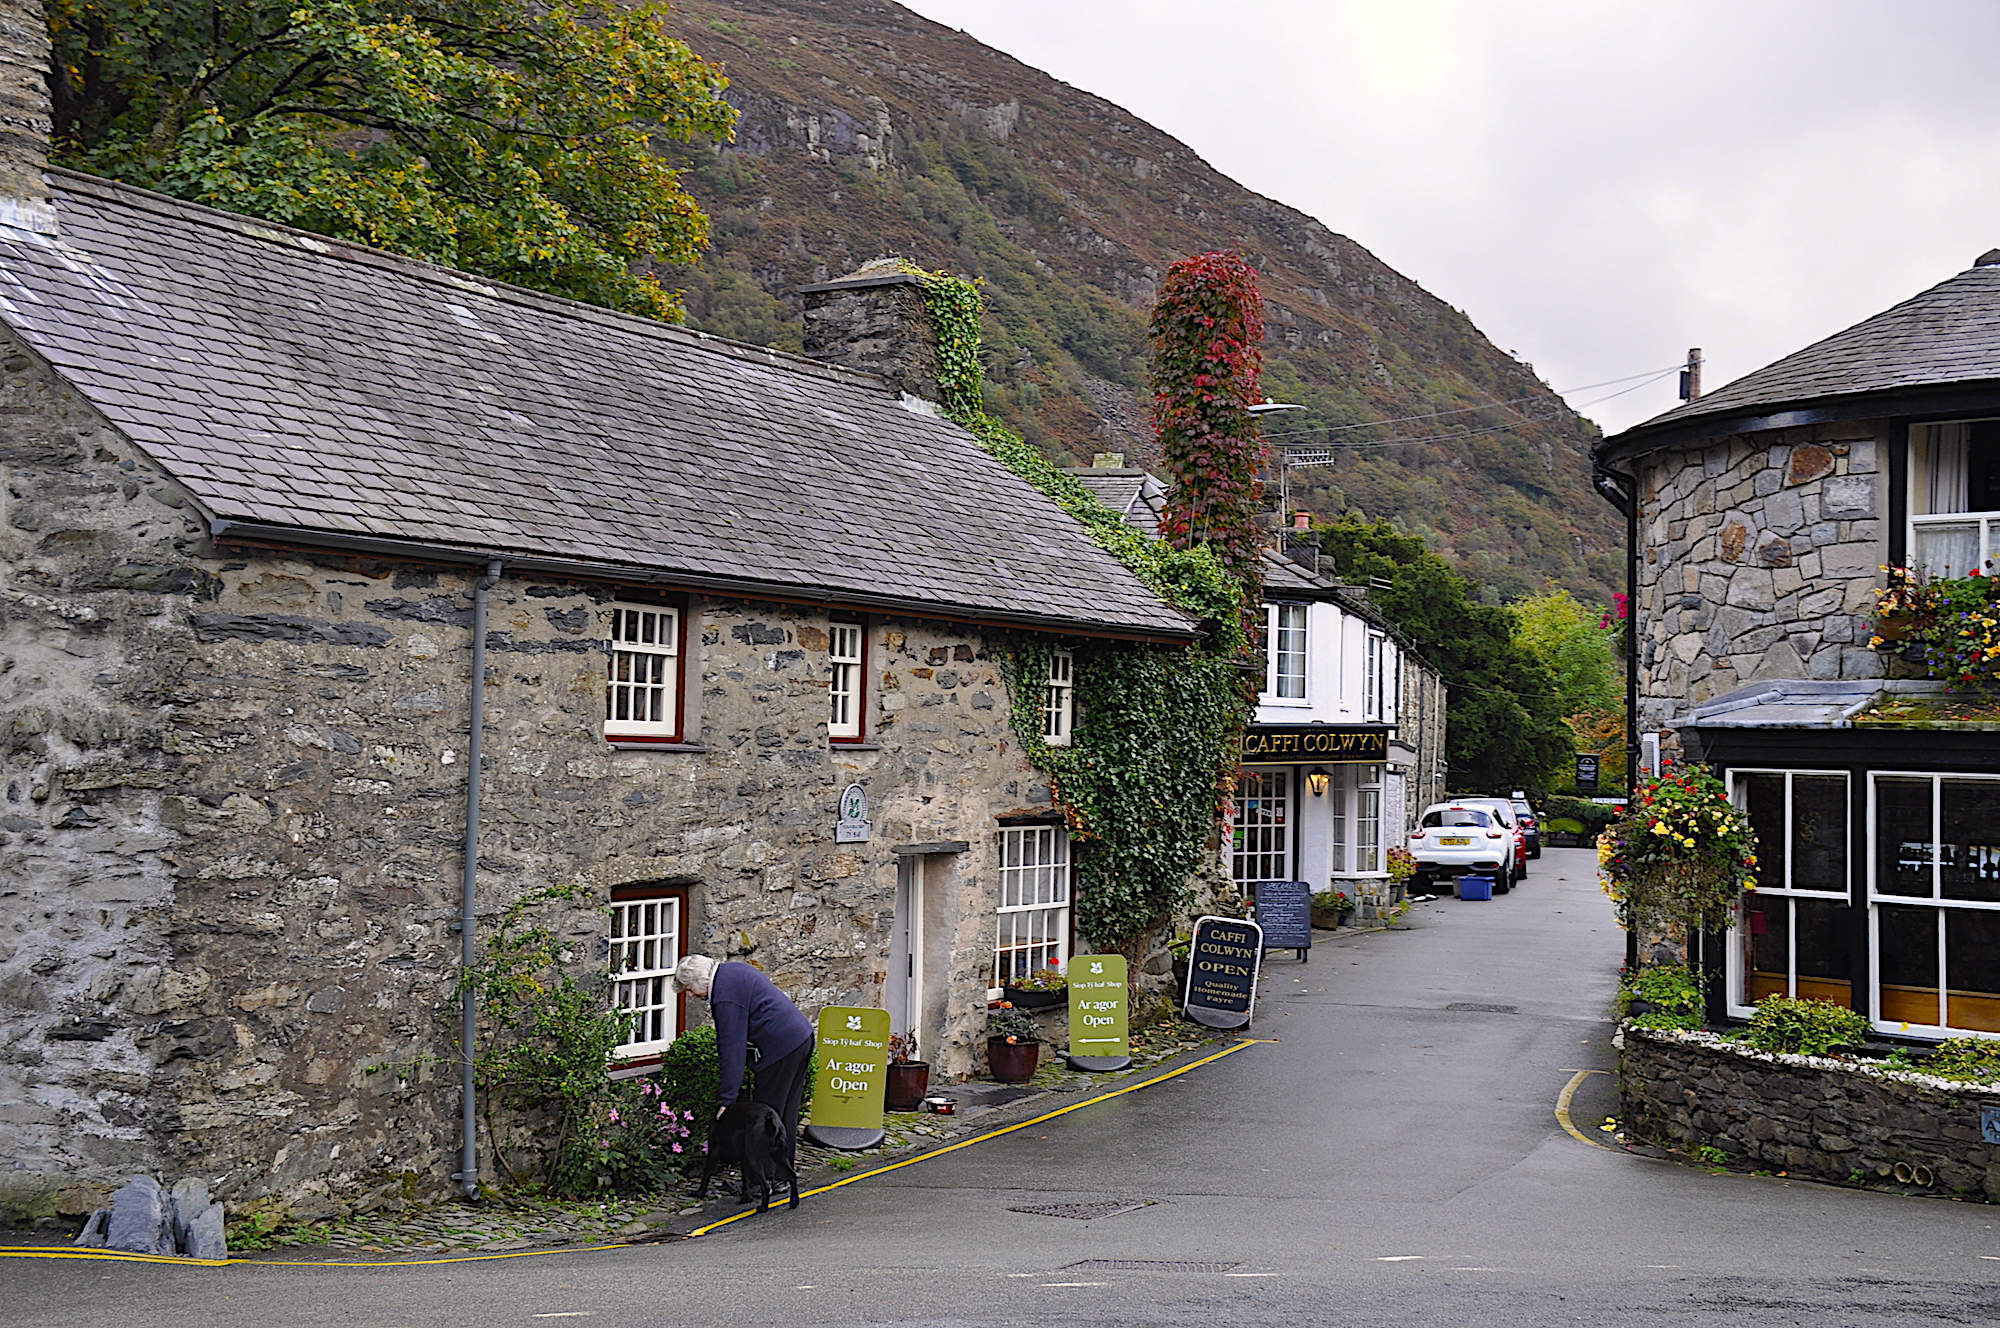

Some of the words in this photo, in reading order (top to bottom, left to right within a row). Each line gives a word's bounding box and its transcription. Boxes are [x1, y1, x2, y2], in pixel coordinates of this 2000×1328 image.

[1245, 734, 1300, 753] CAFFI
[1303, 733, 1385, 752] COLWYN
[1210, 929, 1247, 944] CAFFI
[1200, 942, 1253, 959] COLWYN
[1198, 961, 1250, 977] OPEN
[1194, 986, 1248, 999] Homemade
[1204, 980, 1240, 991] Quality
[1078, 999, 1092, 1010] Ar
[1093, 1000, 1119, 1012] agor
[1206, 995, 1234, 1005] Fayre
[1083, 1014, 1114, 1028] Open
[823, 1037, 839, 1046] Siop
[864, 1039, 883, 1049] Shop
[825, 1058, 842, 1071] Ar
[844, 1061, 876, 1075] agor
[830, 1076, 868, 1093] Open
